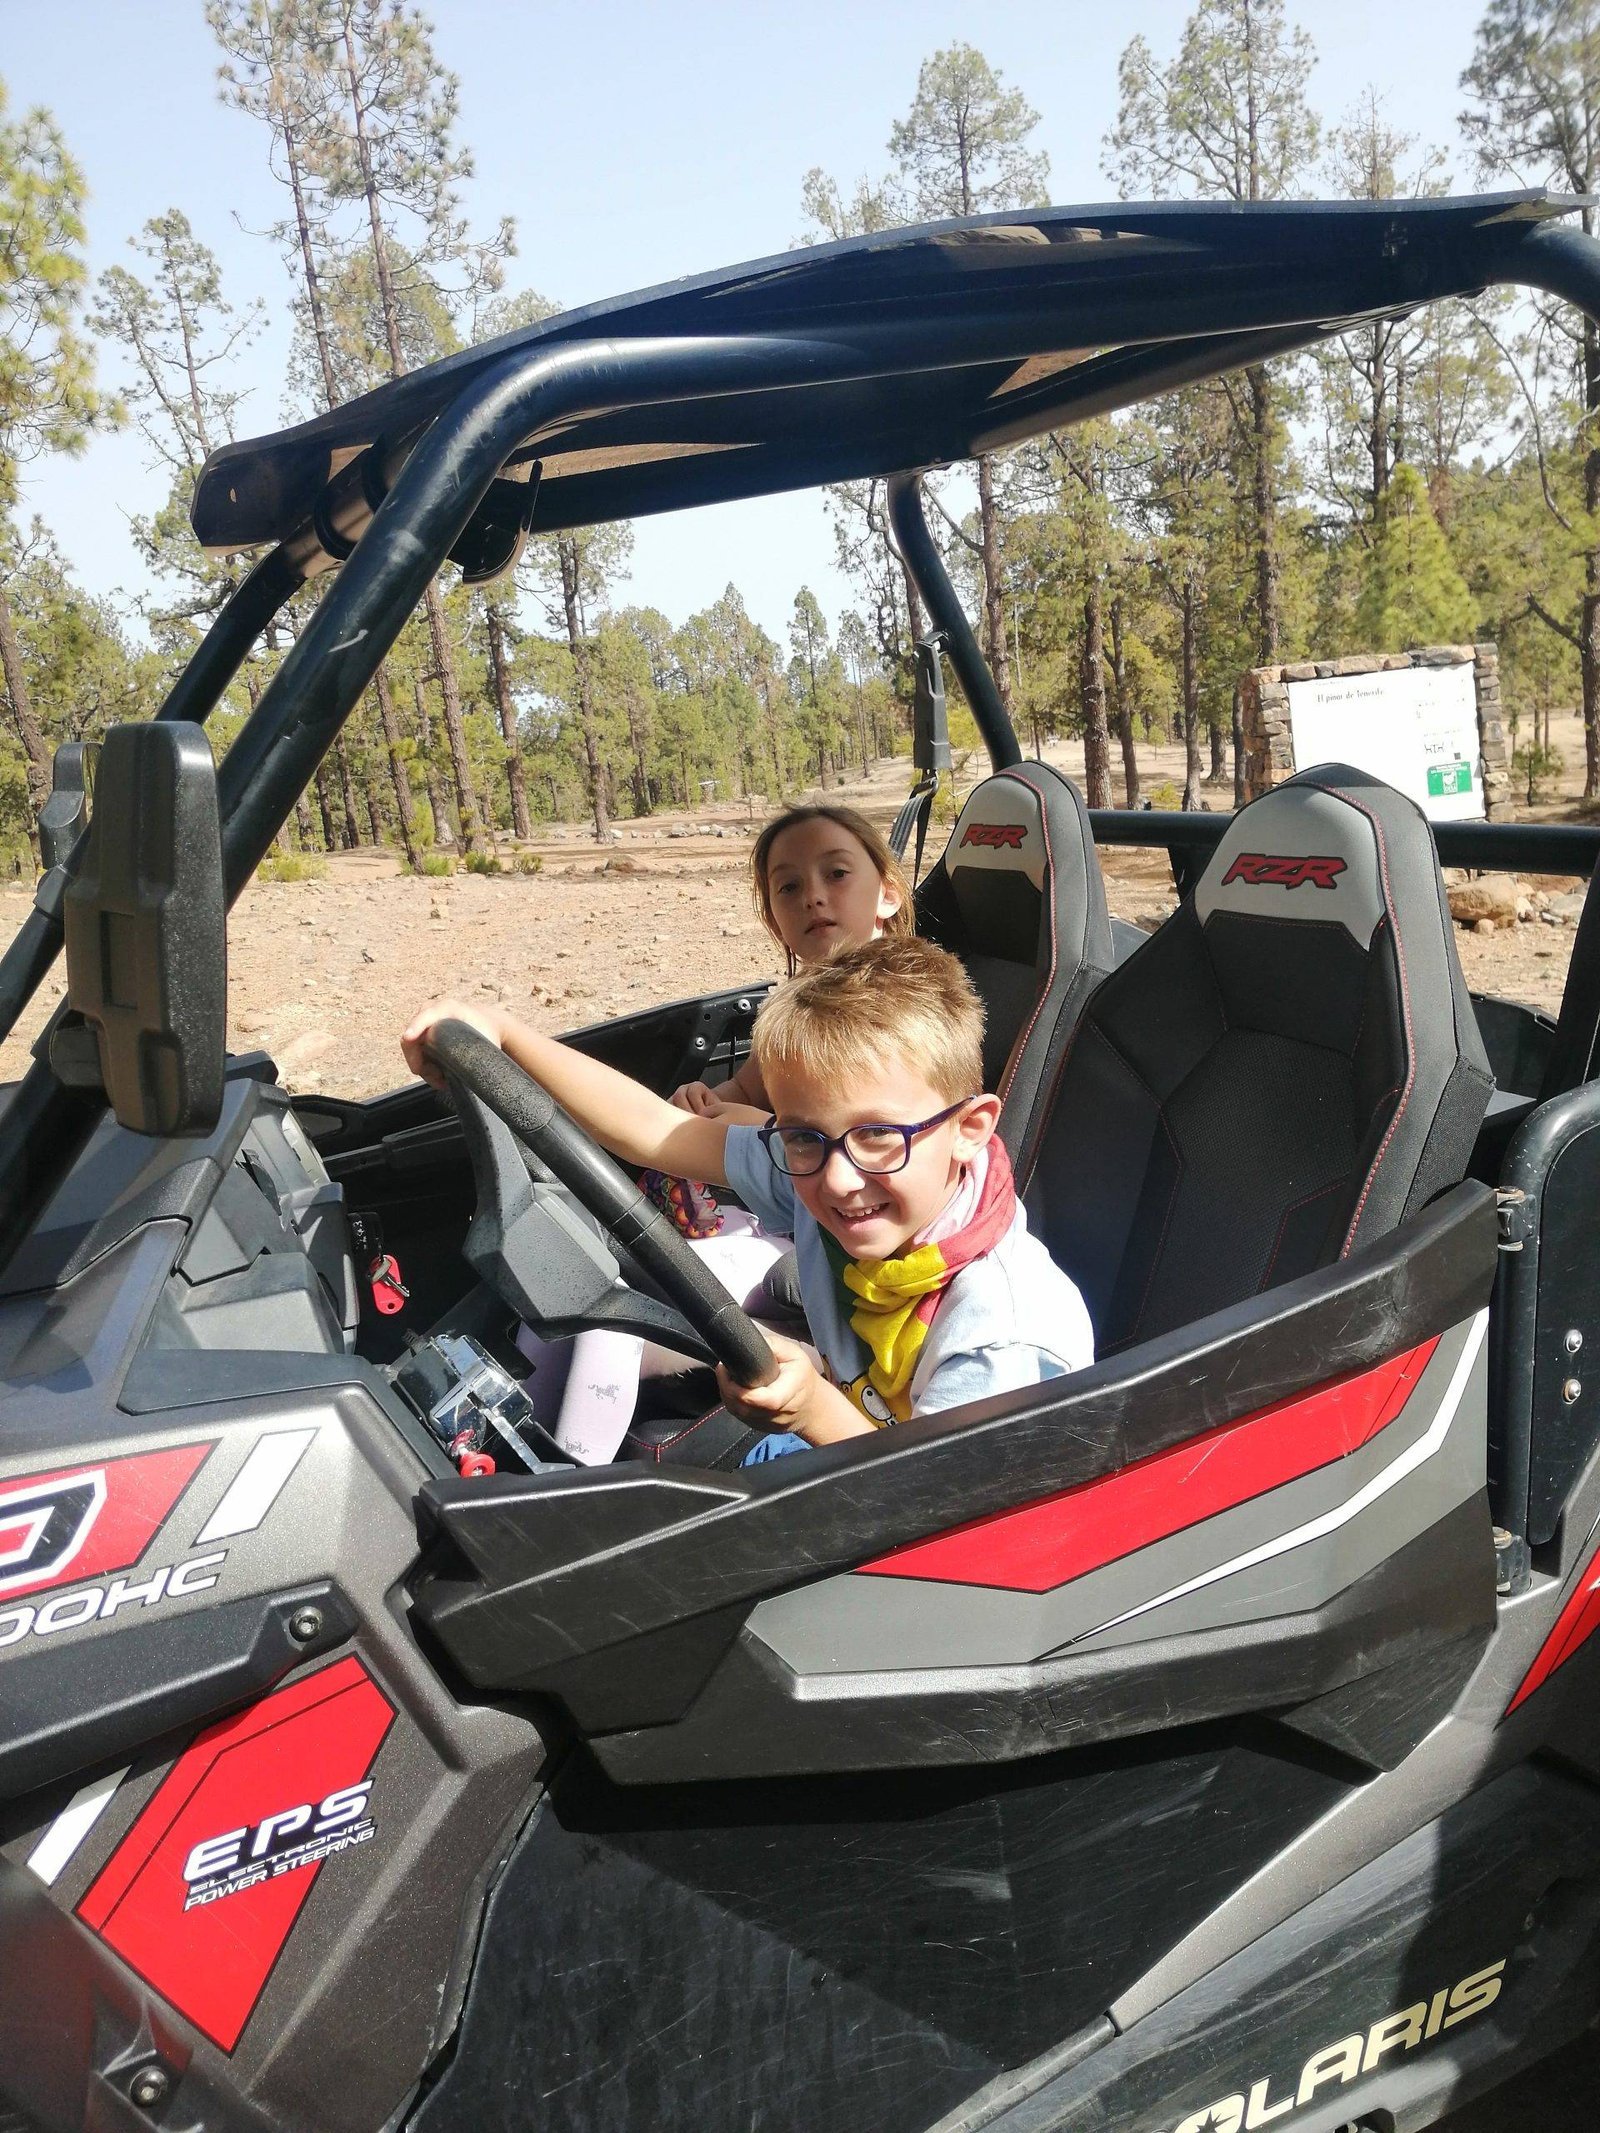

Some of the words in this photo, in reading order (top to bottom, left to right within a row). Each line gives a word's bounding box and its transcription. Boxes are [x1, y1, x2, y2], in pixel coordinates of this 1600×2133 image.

[1346, 690, 1355, 699] de
[960, 823, 1028, 849] RZR
[1221, 853, 1348, 889] RZR
[183, 1780, 374, 1881] EPS
[189, 1818, 372, 1895] ELECTRONIC
[184, 1869, 267, 1912] POWER
[274, 1827, 375, 1876] STEERING
[1160, 1958, 1507, 2133] OLARIS
